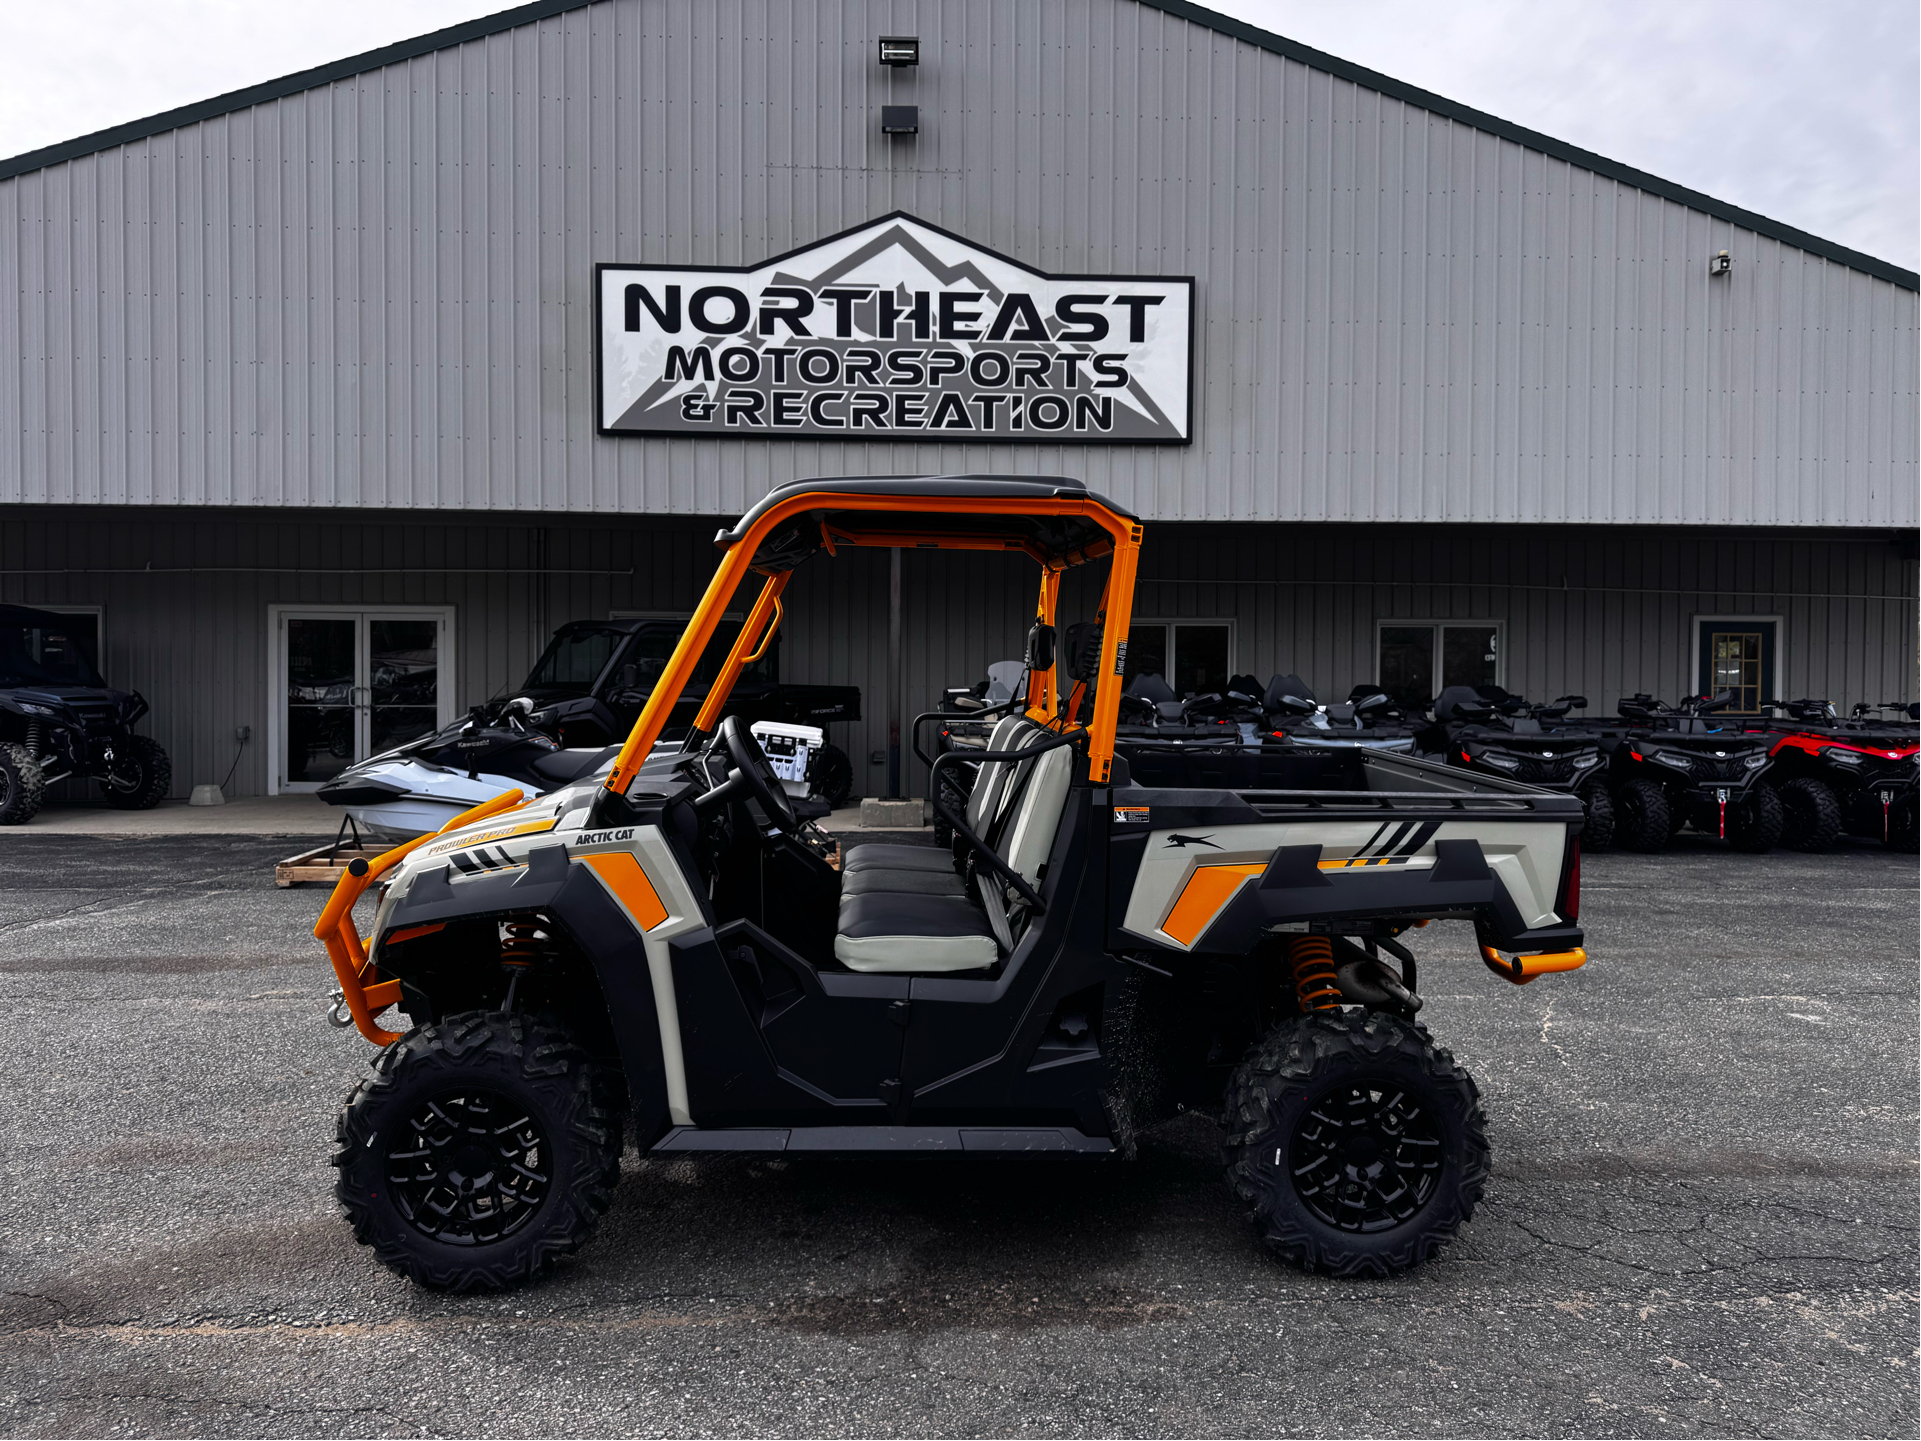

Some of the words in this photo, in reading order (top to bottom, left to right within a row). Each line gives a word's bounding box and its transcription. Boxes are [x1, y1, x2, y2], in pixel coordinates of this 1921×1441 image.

[623, 283, 1167, 344] NORTHEAST
[663, 345, 1130, 389] MOTORSPORTS
[681, 394, 717, 421] &
[726, 390, 1113, 431] RECREATION
[428, 833, 487, 856] PROWLER
[487, 826, 516, 839] PRO
[575, 830, 614, 845] ARCTIC
[615, 828, 635, 840] CAT
